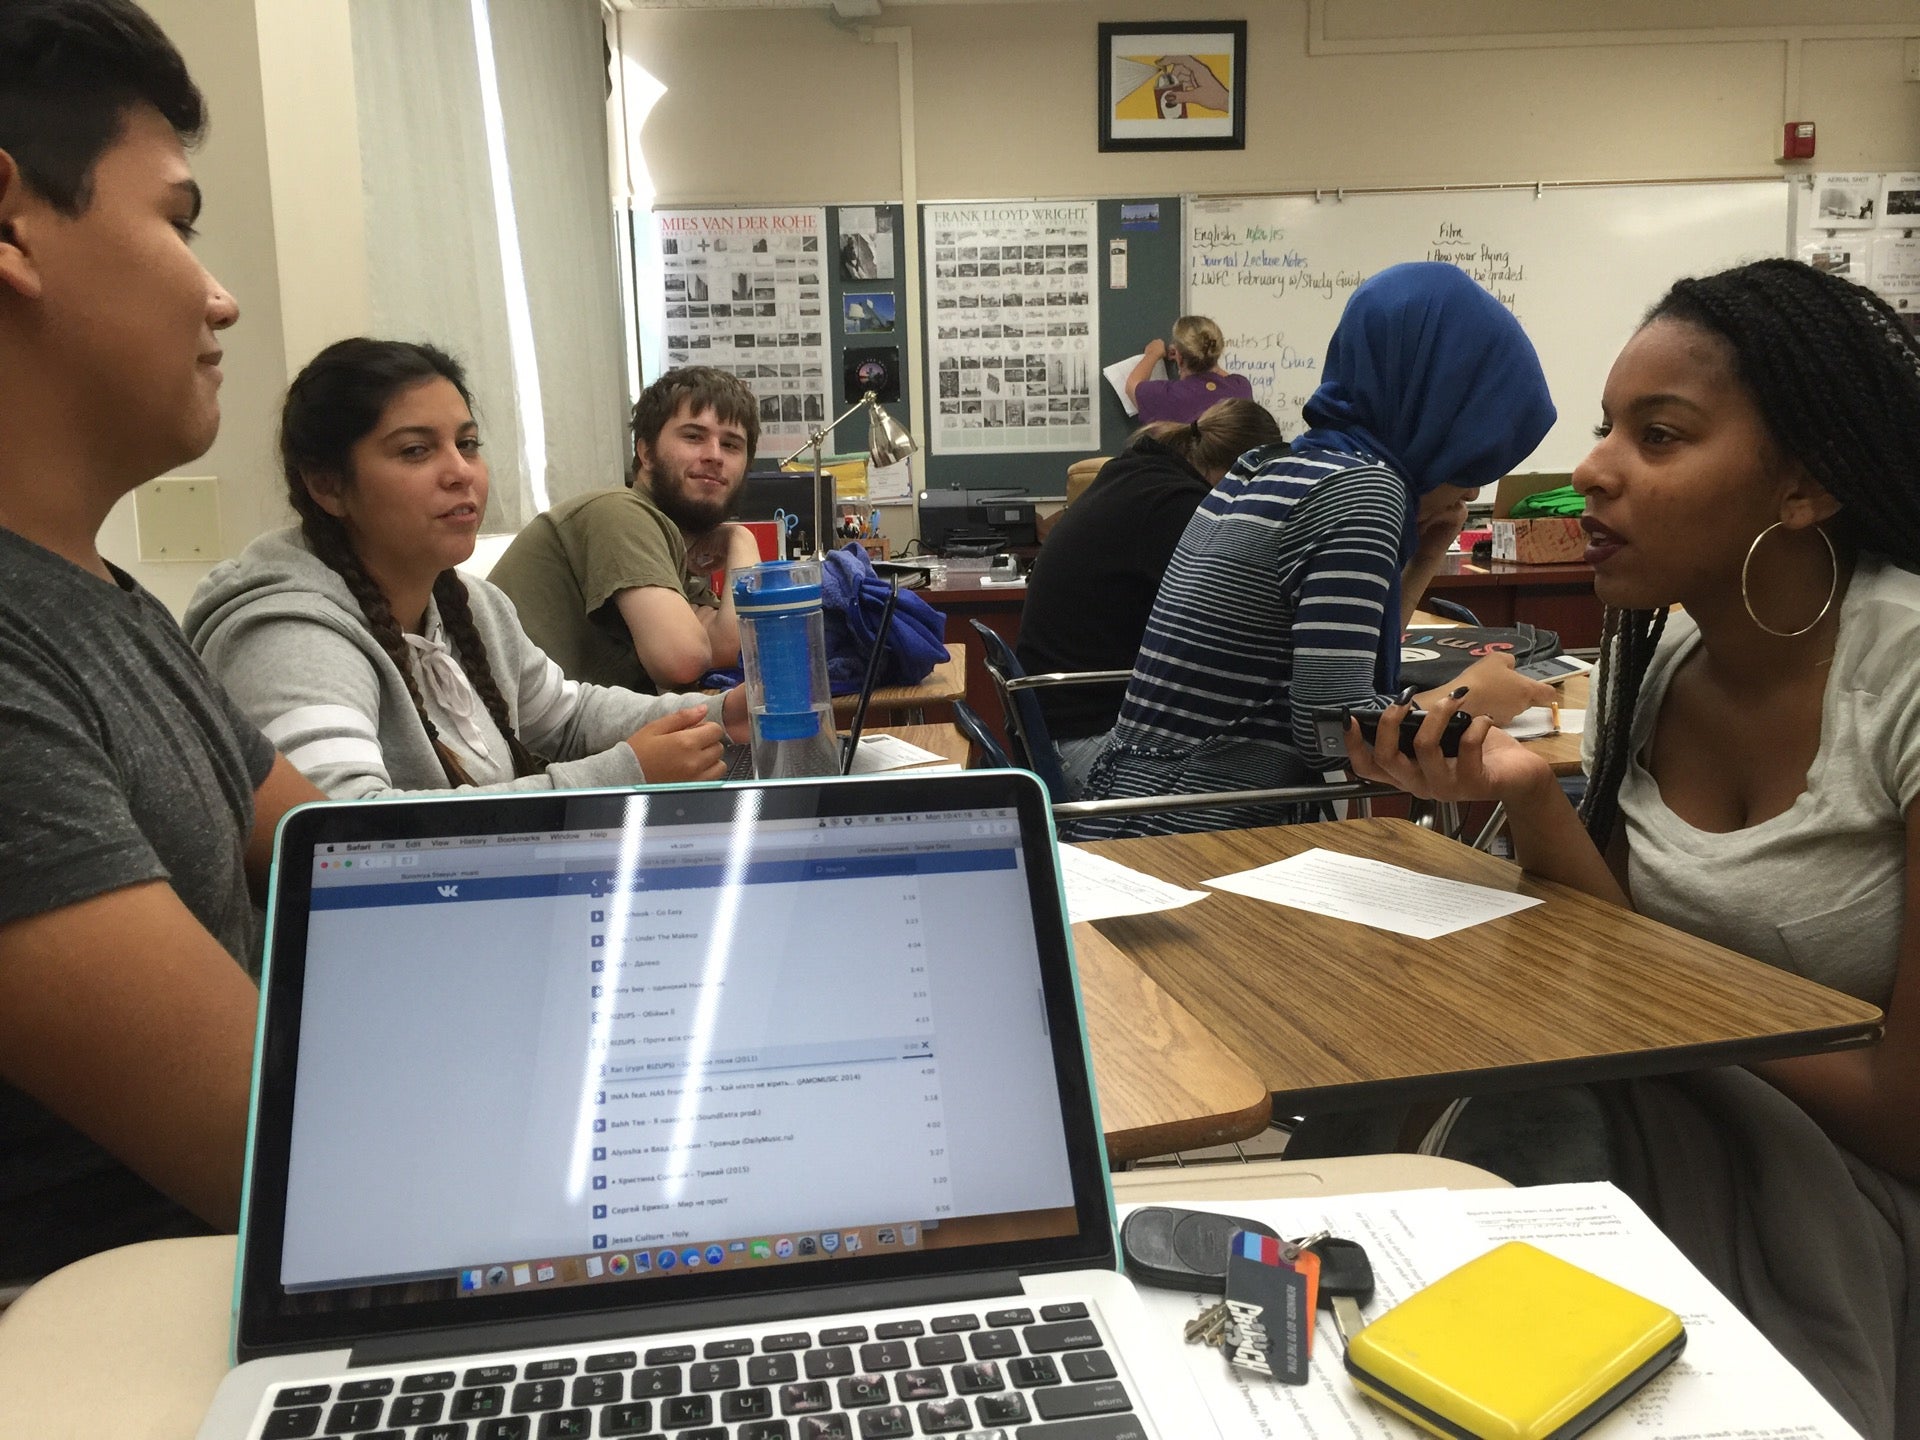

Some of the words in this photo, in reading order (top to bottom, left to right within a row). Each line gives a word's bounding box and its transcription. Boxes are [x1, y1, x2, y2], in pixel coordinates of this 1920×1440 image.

[662, 217, 699, 231] MIES
[702, 216, 734, 230] VAN
[738, 215, 769, 230] DER
[773, 214, 817, 229] ROHE
[934, 210, 982, 223] FRANK
[984, 209, 1029, 221] LLOYD
[1032, 208, 1088, 220] WRIGHT
[1194, 224, 1236, 248] English
[1238, 271, 1285, 298] February
[1225, 353, 1275, 377] February
[459, 837, 487, 846] History
[497, 835, 540, 843] Bookmarks
[550, 832, 580, 841] Window
[611, 1147, 642, 1156] Alyosha
[612, 1205, 639, 1215] Сергей
[677, 1200, 694, 1208] Мир
[612, 1236, 633, 1246] Jesus
[635, 1232, 664, 1242] Culture
[671, 1230, 690, 1239] Holy
[1064, 1334, 1093, 1343] delete
[1225, 1299, 1273, 1376] CRUNCH
[1093, 1398, 1123, 1408] return
[560, 1419, 570, 1429] R
